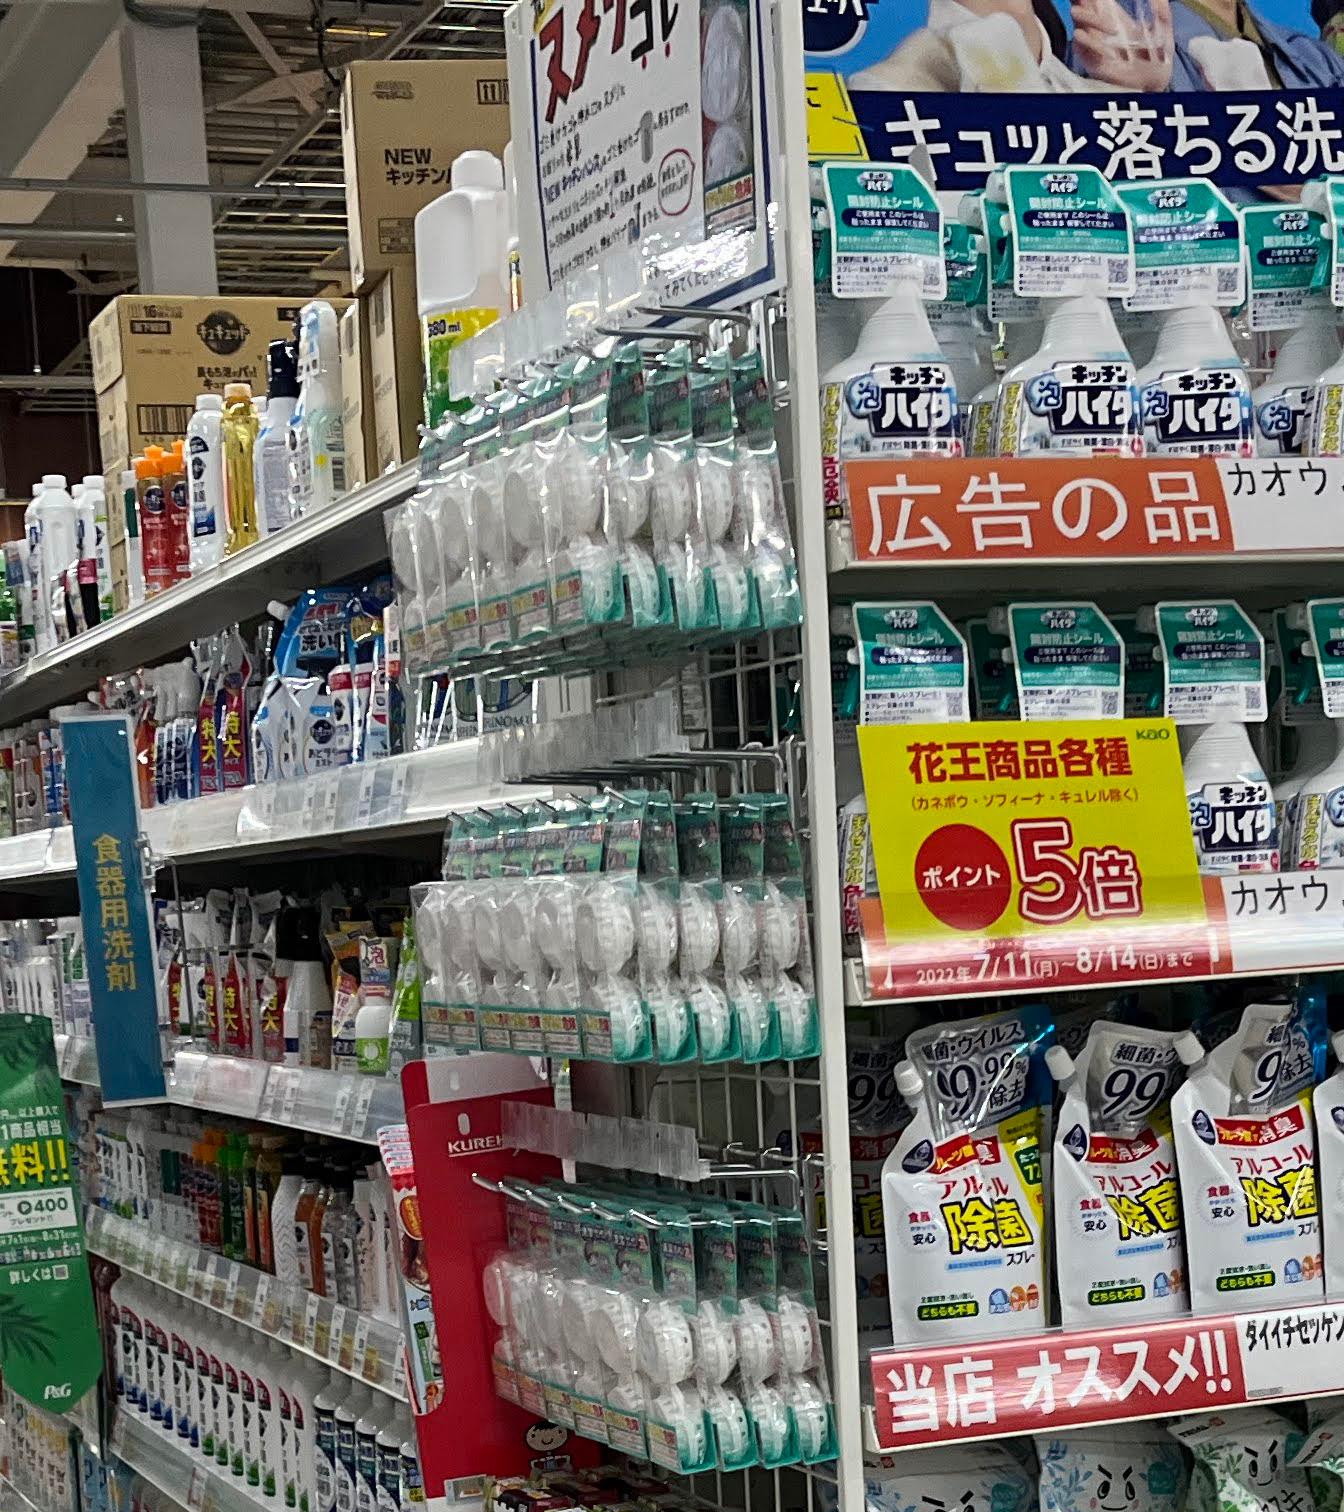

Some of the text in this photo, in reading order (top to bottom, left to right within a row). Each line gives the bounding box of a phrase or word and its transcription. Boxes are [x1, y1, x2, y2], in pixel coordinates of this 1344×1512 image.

[384, 148, 432, 165] NEW
[867, 475, 1224, 557] 広告の品
[1227, 462, 1329, 498] カオウ
[906, 736, 1134, 785] 花王商品各種
[921, 816, 1144, 926] ポイント 5倍
[1230, 877, 1331, 914] カオウ
[92, 830, 138, 995] 食器用洗剤
[33, 1196, 69, 1213] 400
[940, 1196, 1035, 1255] 除菌
[42, 1380, 74, 1402] P&G
[885, 1353, 998, 1433] 当店
[1016, 1327, 1234, 1416] オススメ!!
